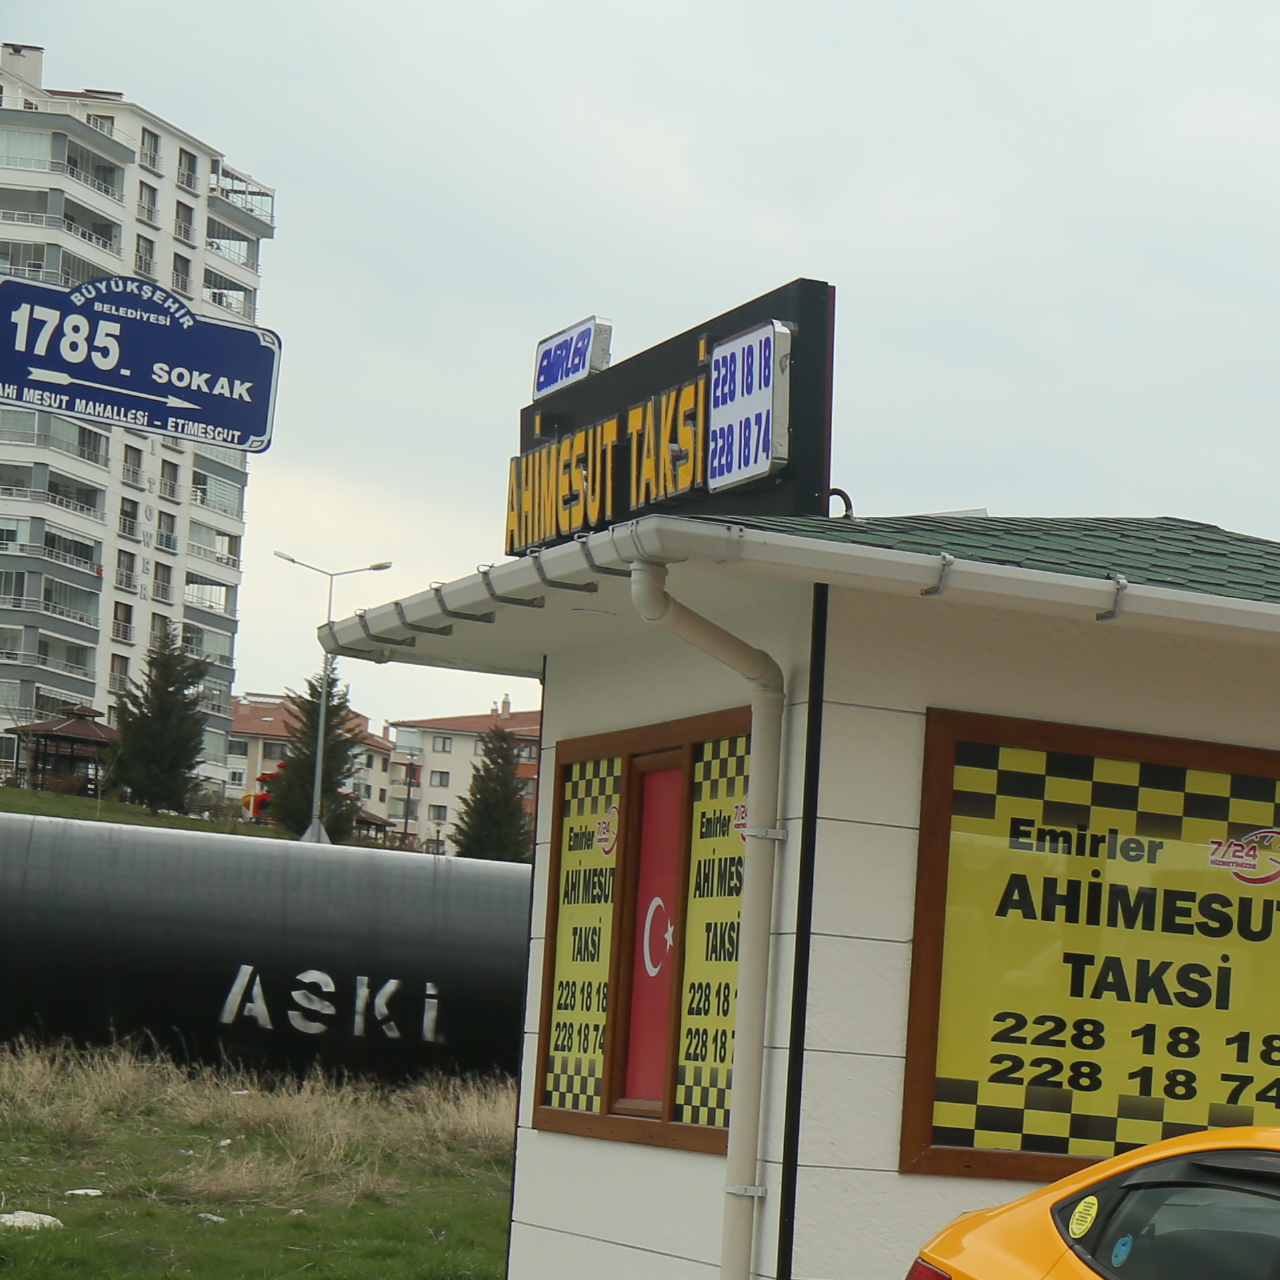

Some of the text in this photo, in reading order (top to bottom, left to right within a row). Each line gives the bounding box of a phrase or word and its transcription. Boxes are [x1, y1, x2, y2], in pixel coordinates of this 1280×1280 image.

[70, 277, 194, 329] BÜYÜKŞEHİR
[94, 301, 171, 327] BELEDİYESİ
[152, 362, 254, 402] SOKAK
[712, 336, 772, 409] 228 18 18
[22, 388, 70, 409] MESUT
[709, 408, 772, 480] 228 18 74
[1008, 816, 1164, 864] Emirler
[1209, 840, 1259, 861] 7/24
[572, 916, 602, 963] TAKSİ
[556, 980, 609, 1013] 228 18 18
[687, 982, 731, 1017] 228 18
[1062, 953, 1233, 1011] TAKSİ
[553, 1022, 574, 1053] 228
[577, 1023, 590, 1055] 18
[684, 1027, 709, 1063] 228
[712, 1028, 728, 1064] 18
[990, 1011, 1106, 1051] 228
[1130, 1023, 1201, 1059] 18
[987, 1053, 1103, 1093] 228
[1127, 1066, 1198, 1101] 18
